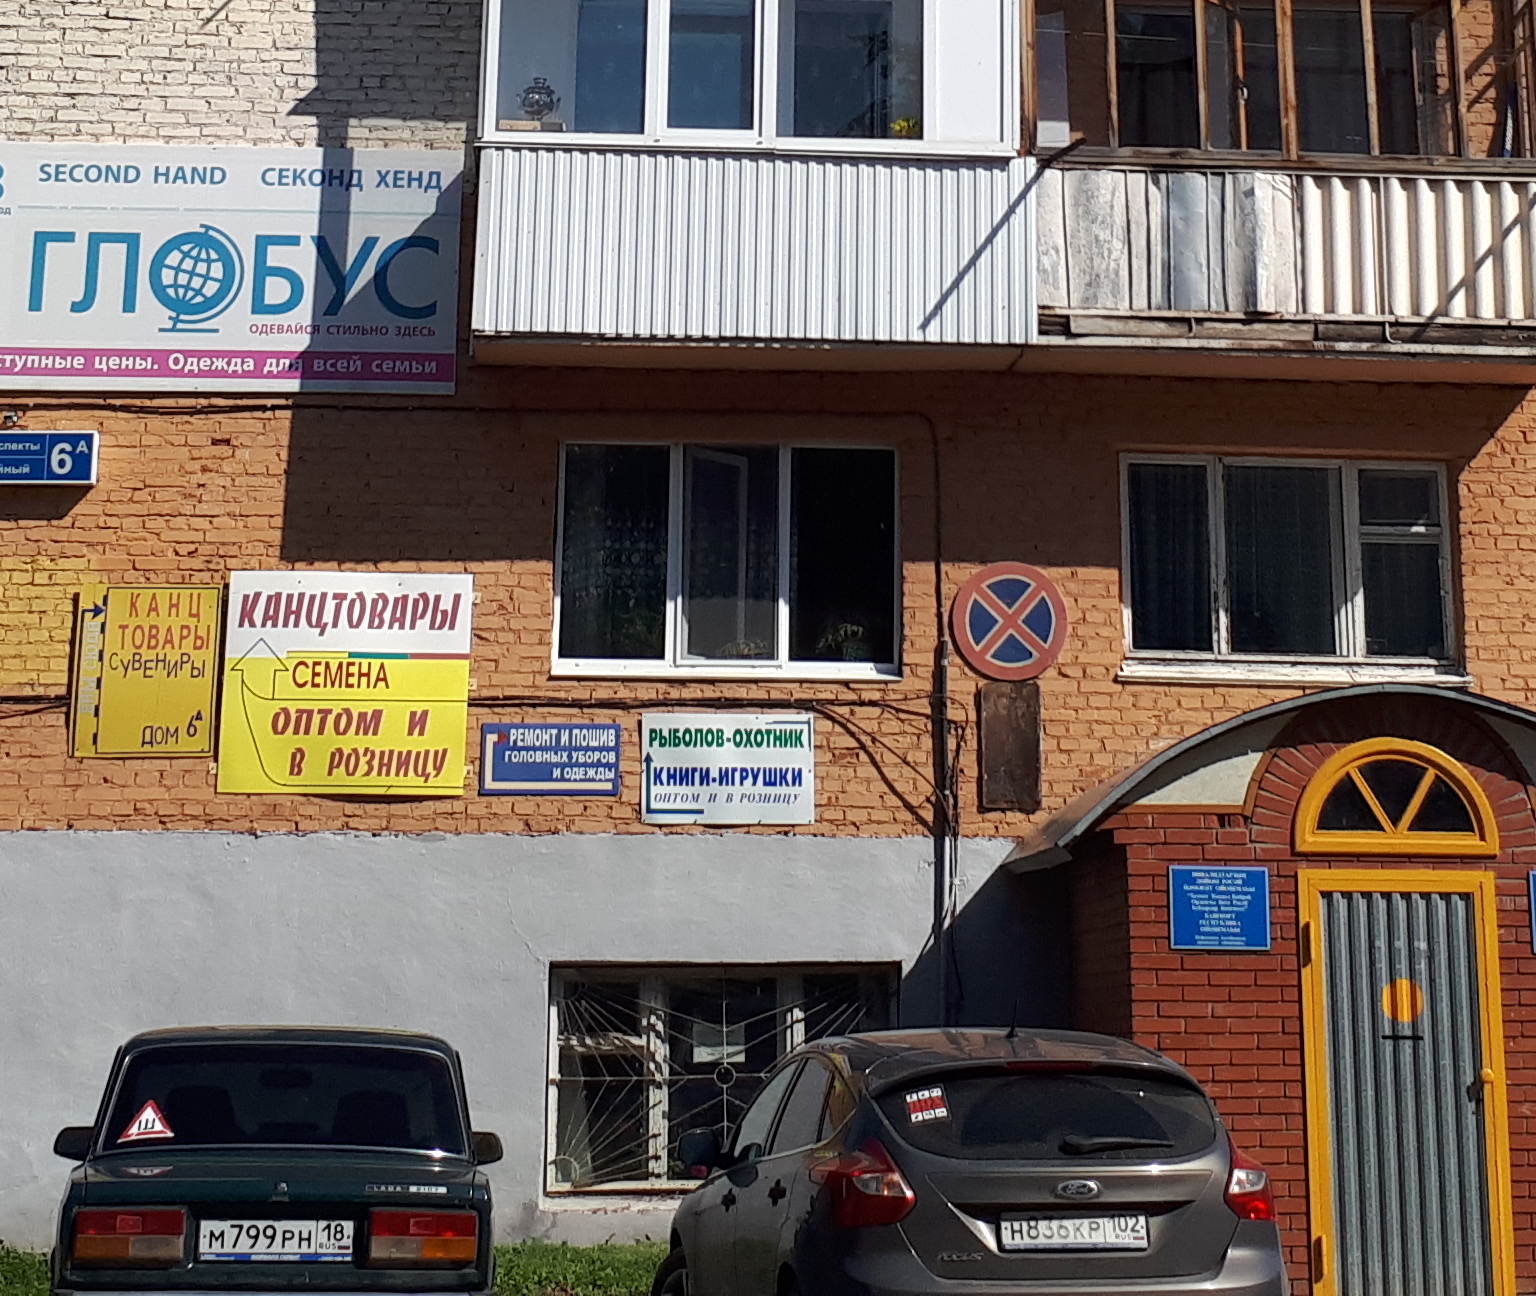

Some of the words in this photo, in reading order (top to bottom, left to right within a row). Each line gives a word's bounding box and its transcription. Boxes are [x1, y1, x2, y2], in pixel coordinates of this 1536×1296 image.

[37, 163, 141, 184] SECOND
[153, 165, 227, 185] HAND
[260, 167, 363, 192] СЕКОНД
[375, 169, 443, 193] ХЕНД
[27, 227, 440, 321] ГЛОБУС
[249, 322, 321, 336] ОДЕВАЙСЯ
[326, 323, 389, 336] СТИЛЬНО
[394, 325, 437, 337] ЗДЕСЬ
[94, 354, 159, 372] цены.
[168, 353, 255, 375] Одежда
[263, 357, 303, 375] для
[313, 356, 362, 372] всей
[371, 359, 437, 374] семьи
[128, 592, 201, 623] КАНЦ
[238, 591, 462, 637] КАНЦТОВАРЫ
[118, 624, 211, 650] ТОВАРЫ
[109, 652, 206, 678] СУВЕНИРЫ
[292, 661, 390, 690] СЕМЕНА
[271, 707, 384, 737] ОПТОМ
[406, 709, 429, 737] И
[141, 725, 179, 748] ДОМ
[509, 728, 558, 747] РЕМОНТ
[560, 728, 569, 746] И
[572, 728, 616, 747] ПОШИВ
[648, 727, 804, 748] РЫБОЛОВ-ОХОТНИК
[288, 747, 306, 777] В
[327, 747, 449, 784] РОЗНИЦУ
[504, 750, 569, 763] ГОЛОВНЫХ
[571, 751, 616, 763] УБОРОВ
[552, 767, 561, 779] И
[563, 767, 615, 781] ОДЕЖДЫ
[653, 766, 803, 787] КНИГИ-ИГРУШКИ
[654, 792, 700, 804] ОПТОМ
[707, 792, 717, 804] И
[725, 792, 734, 804] В
[739, 792, 800, 805] РОЗНИЦУ
[1112, 1215, 1141, 1234] 102
[208, 1224, 312, 1249] М799РН
[321, 1223, 345, 1242] 18
[318, 1242, 337, 1250] RUS
